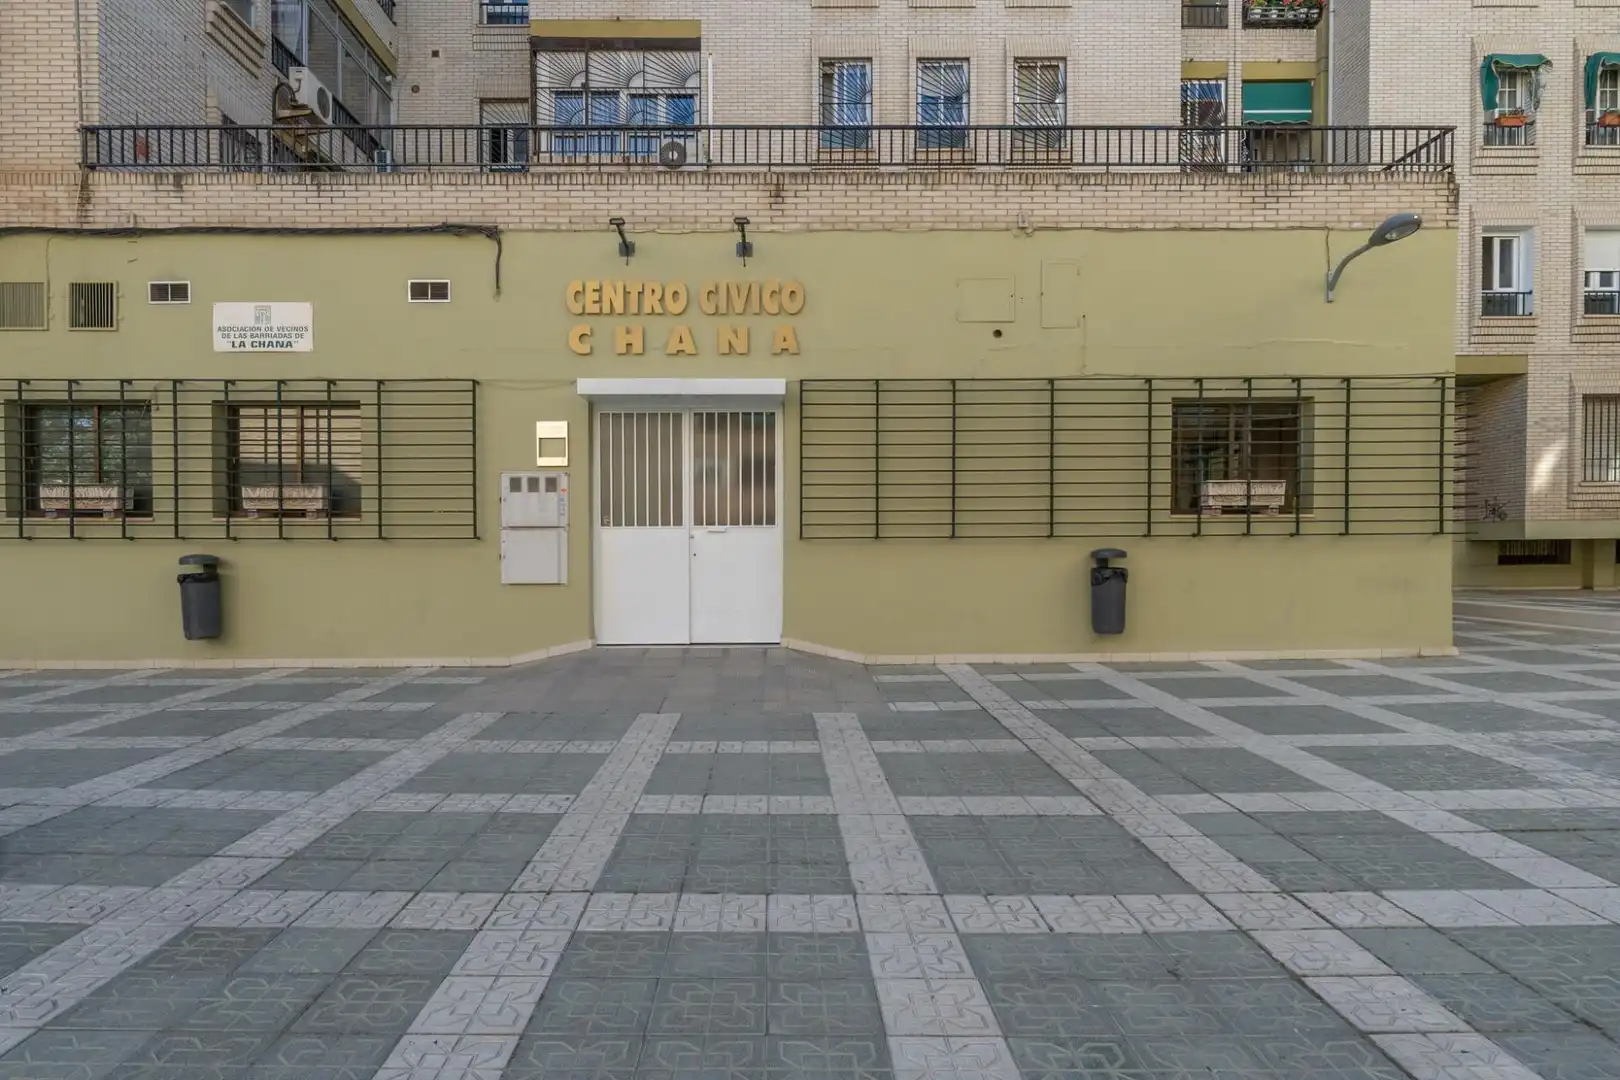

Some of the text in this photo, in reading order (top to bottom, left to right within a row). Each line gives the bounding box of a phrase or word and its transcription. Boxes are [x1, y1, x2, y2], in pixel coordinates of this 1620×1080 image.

[566, 279, 806, 315] CENTRO CIVICO
[264, 325, 274, 333] DE
[276, 325, 309, 333] VECINOS
[568, 323, 800, 355] CHANA
